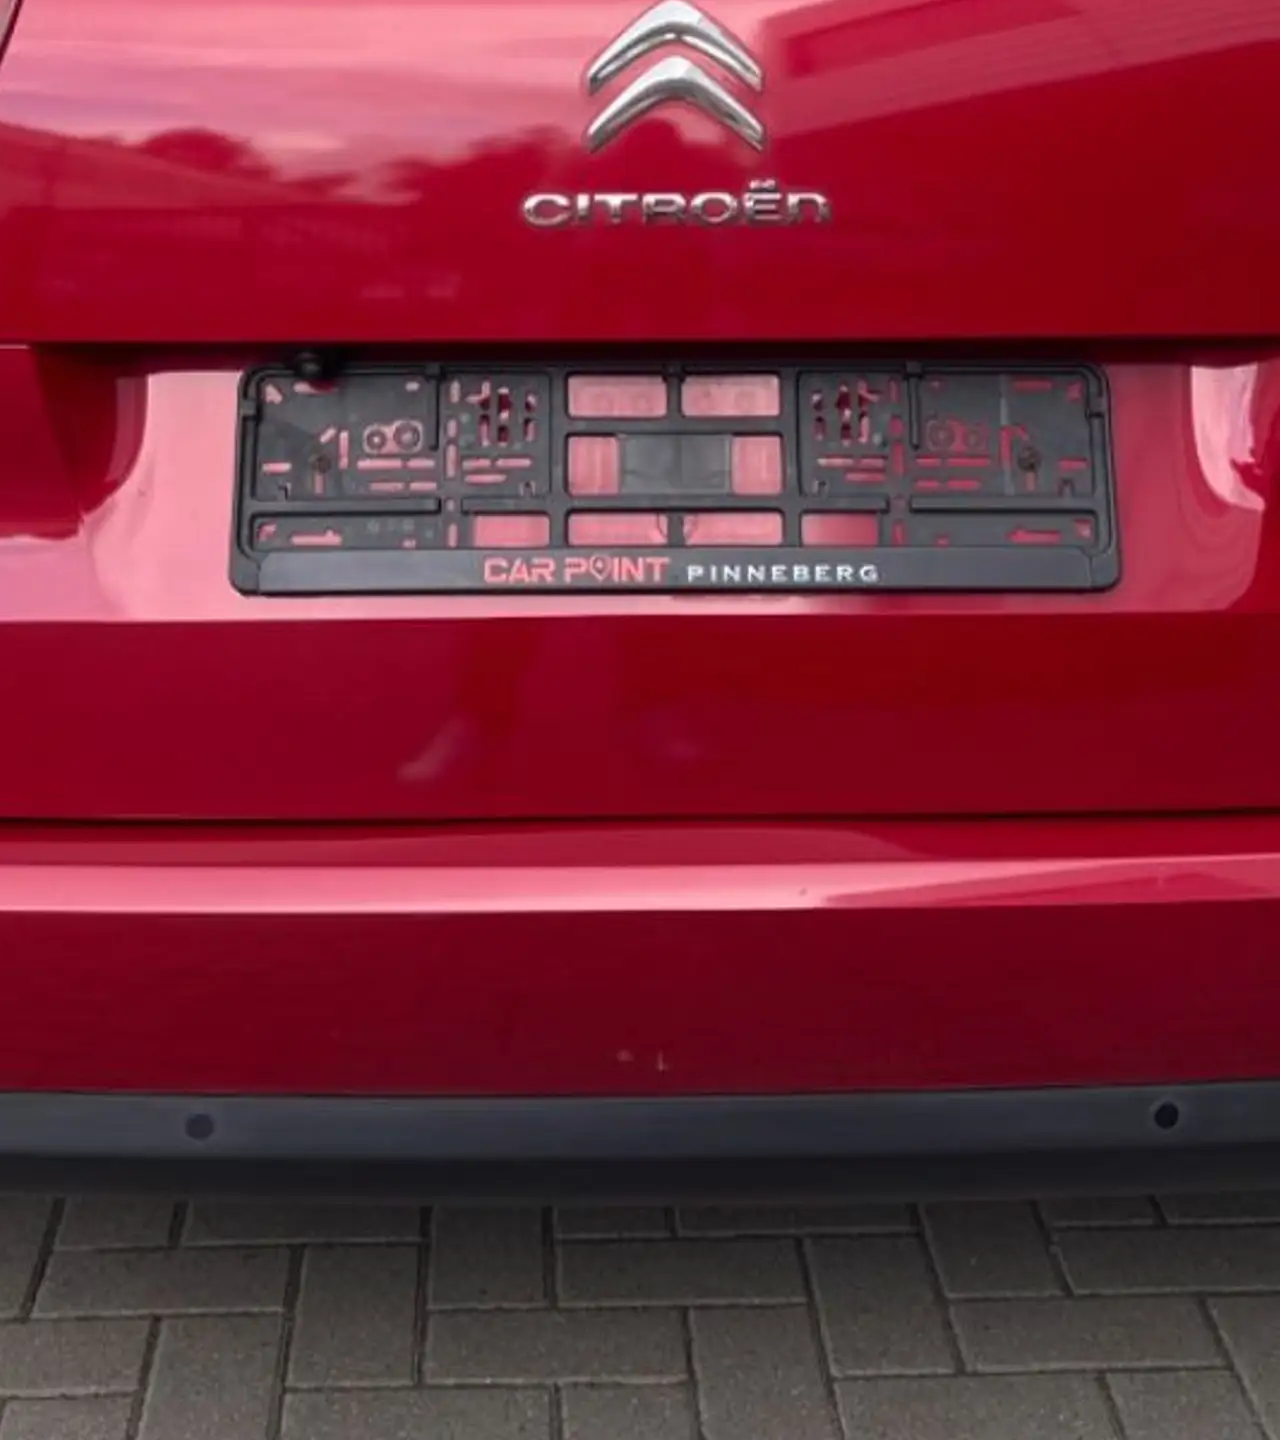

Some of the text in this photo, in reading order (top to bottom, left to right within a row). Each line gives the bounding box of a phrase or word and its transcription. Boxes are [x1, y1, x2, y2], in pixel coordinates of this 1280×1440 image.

[482, 554, 880, 584] CAR POINT PINNEBERG
